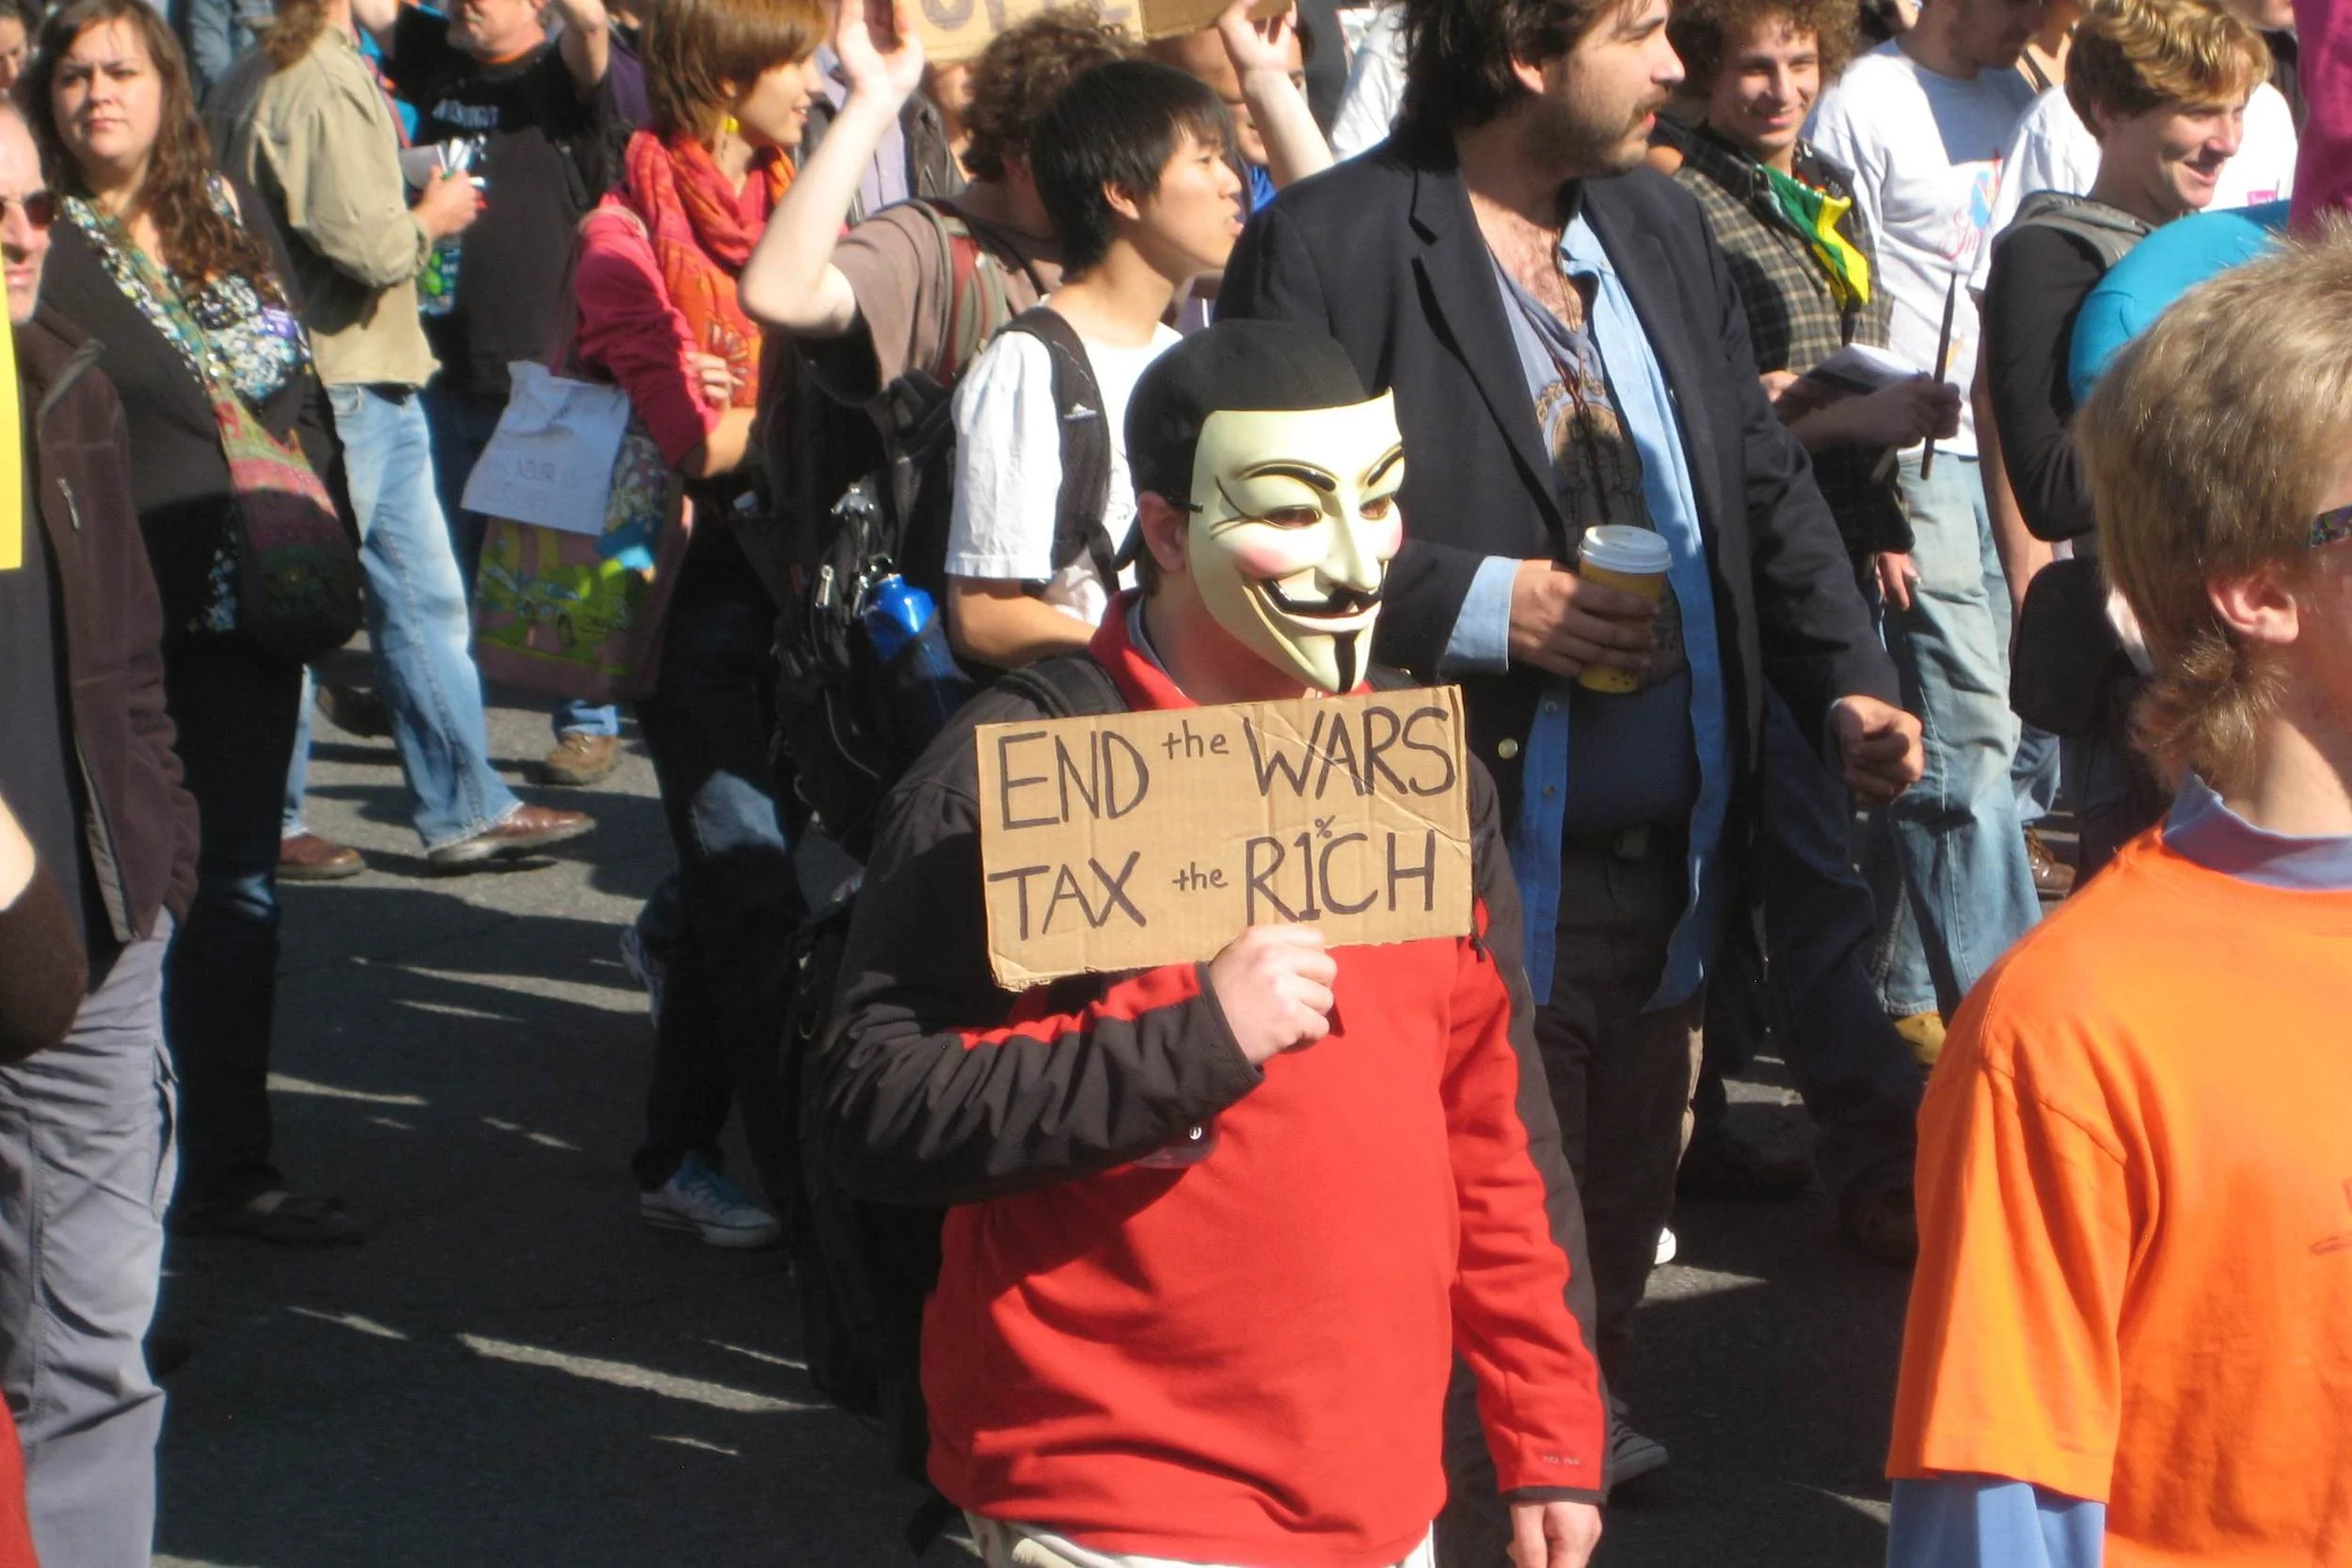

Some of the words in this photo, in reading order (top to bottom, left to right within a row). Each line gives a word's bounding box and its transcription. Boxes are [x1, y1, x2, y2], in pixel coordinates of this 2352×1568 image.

[998, 731, 1150, 831] END
[1161, 720, 1230, 760] the
[1243, 705, 1457, 800] WARS
[987, 851, 1147, 941] TAX
[1172, 862, 1229, 892] the
